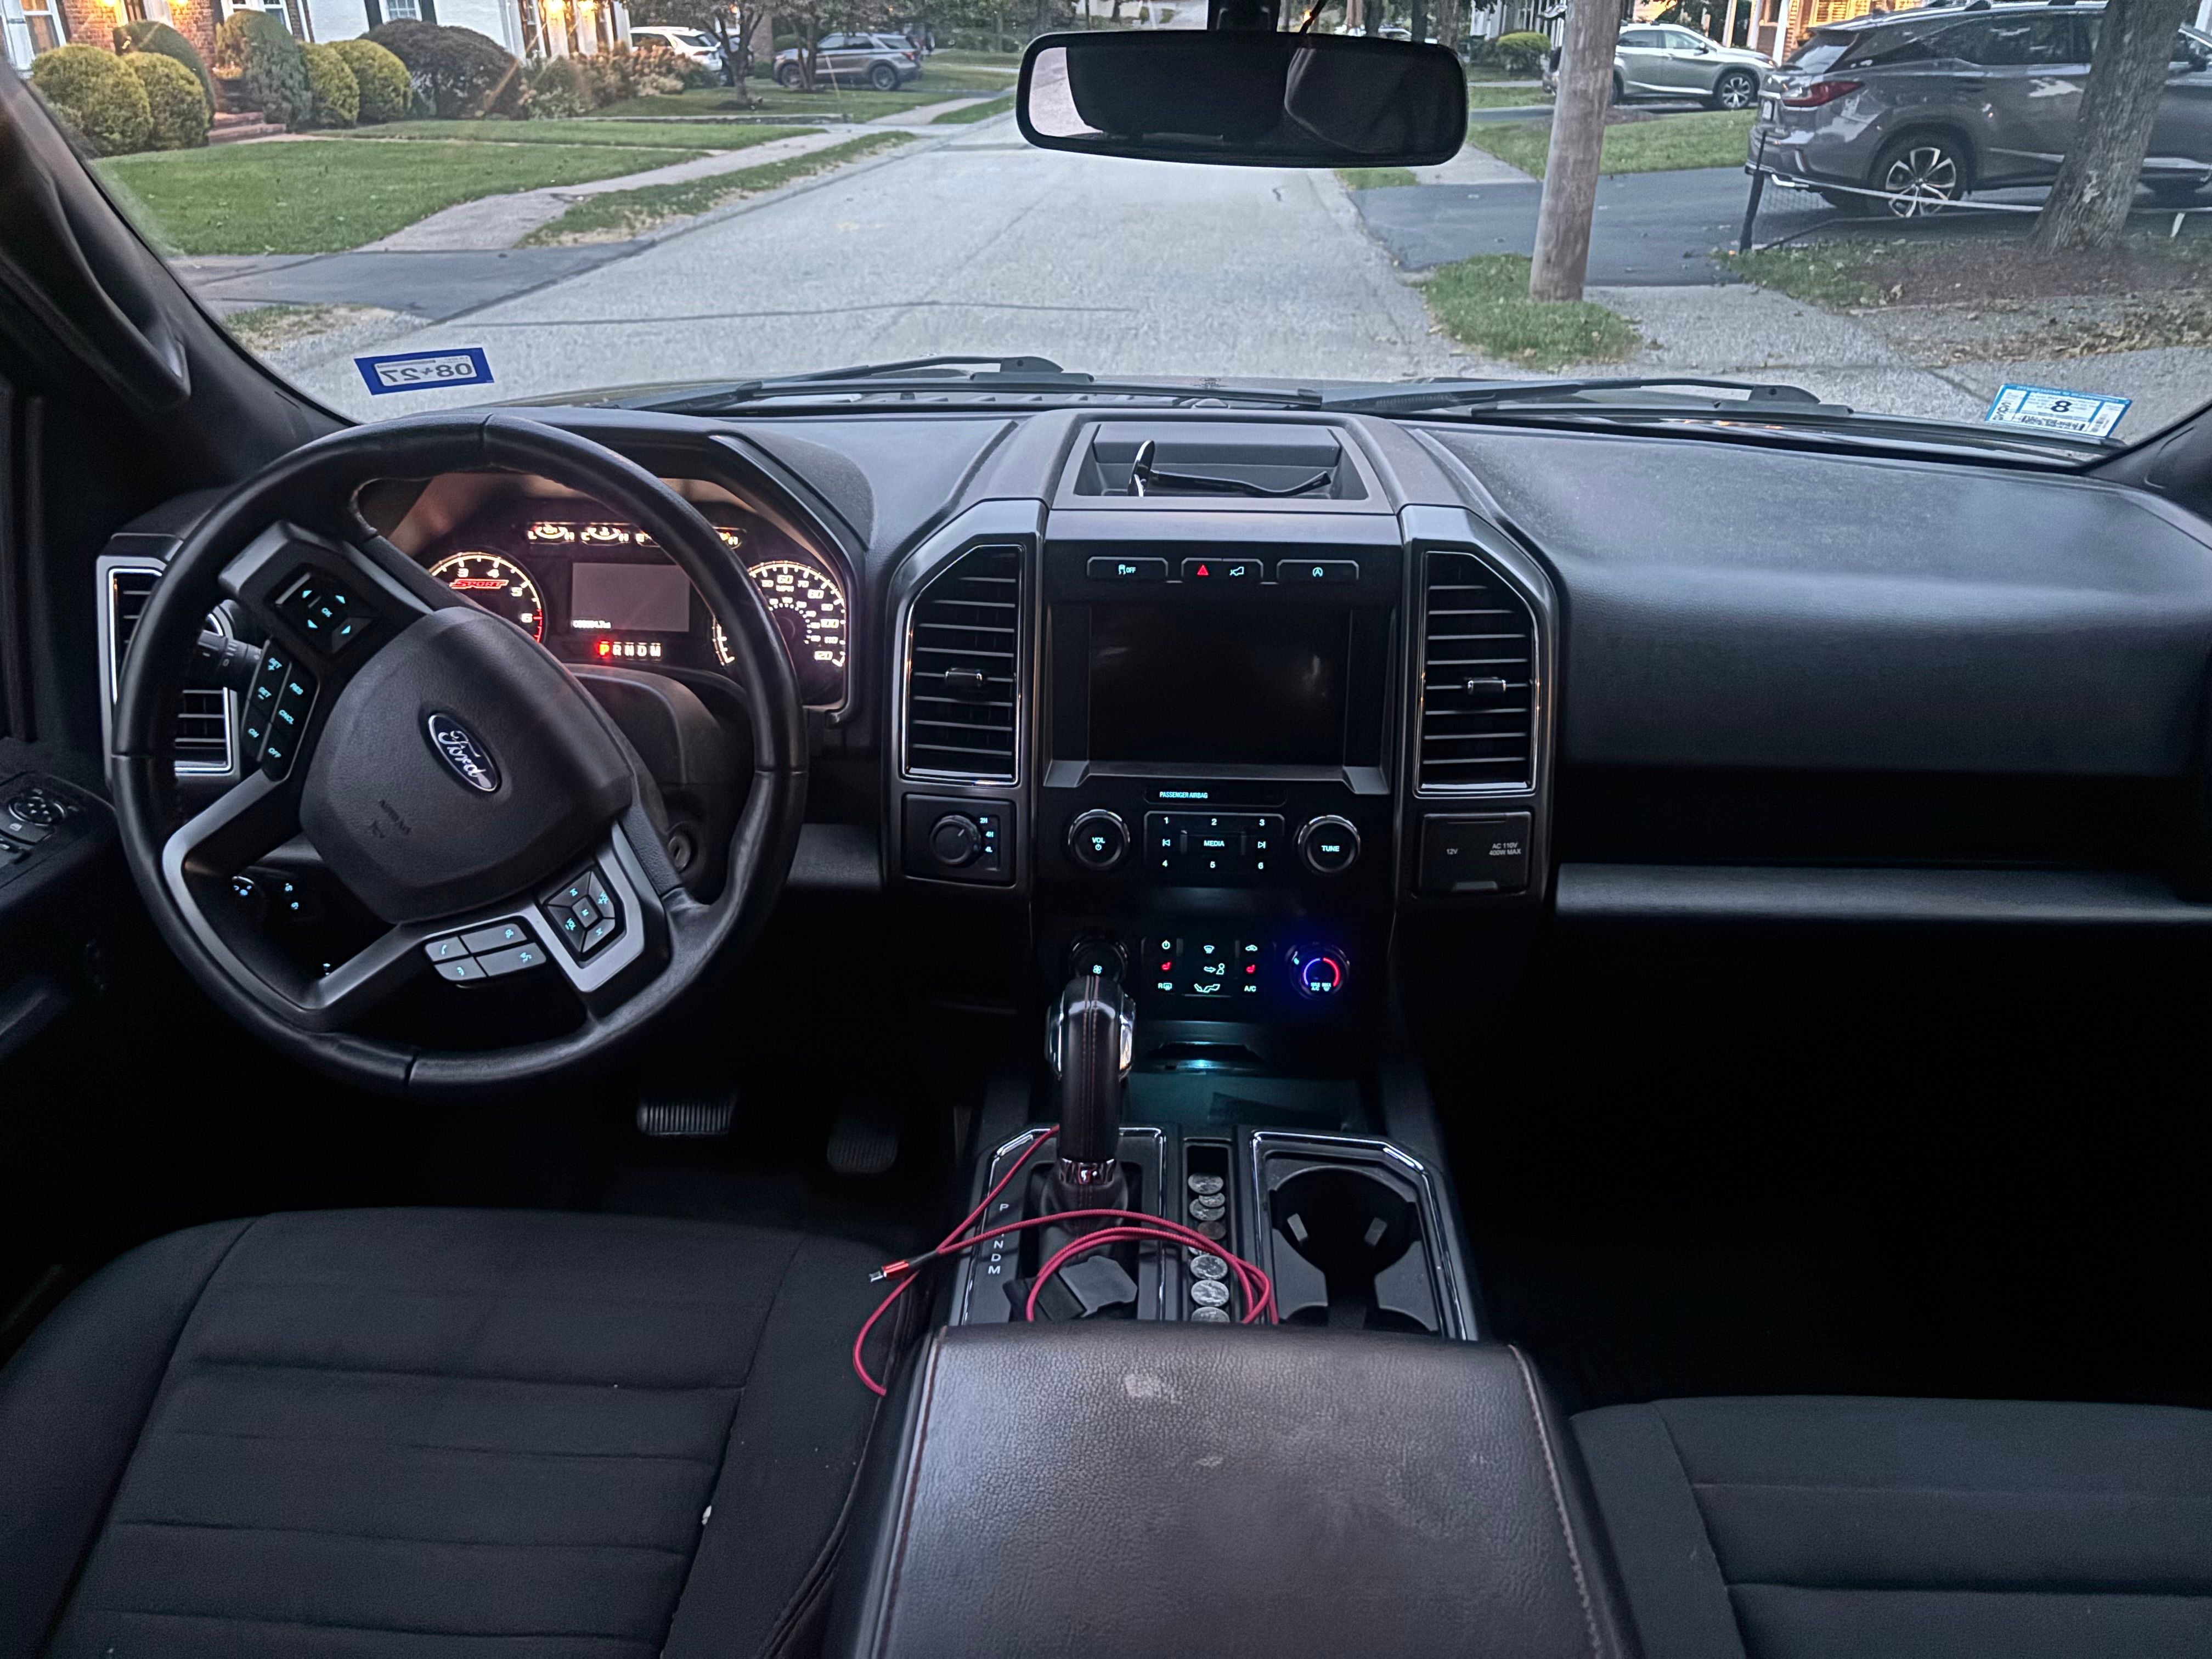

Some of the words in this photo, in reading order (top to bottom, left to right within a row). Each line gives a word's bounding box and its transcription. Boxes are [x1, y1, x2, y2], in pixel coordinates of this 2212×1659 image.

[528, 531, 537, 539] L
[565, 532, 574, 540] H
[619, 533, 629, 541] H
[728, 537, 738, 545] H
[458, 568, 469, 577] 3
[487, 569, 499, 578] 4
[777, 575, 793, 584] 60
[511, 587, 522, 596] 5
[808, 589, 824, 599] 80
[321, 608, 332, 617] OK
[521, 613, 533, 623] 6
[821, 619, 839, 628] 100
[599, 644, 610, 656] P
[613, 645, 622, 656] R
[625, 645, 634, 656] N
[637, 645, 647, 656] D
[650, 645, 661, 657] M
[815, 651, 833, 660] 120
[279, 709, 294, 725] CNCL
[248, 729, 259, 738] ON
[268, 747, 281, 758] OFF
[438, 731, 487, 778] Ford
[567, 918, 575, 930] VOL
[994, 1240, 1003, 1249] N
[991, 1254, 1001, 1262] D
[988, 1266, 1001, 1274] M
